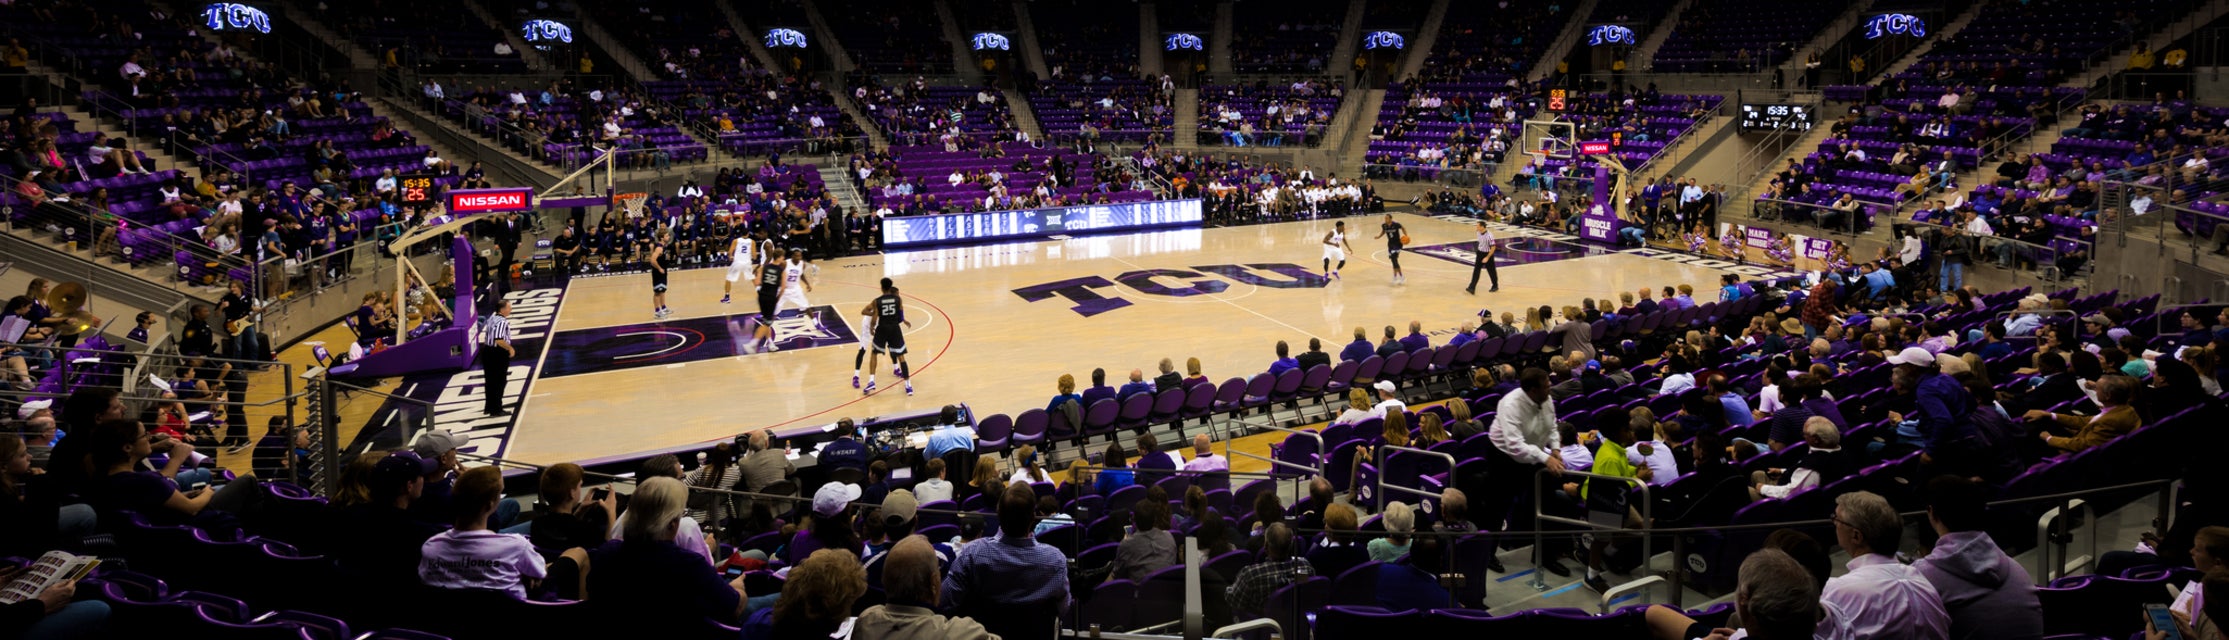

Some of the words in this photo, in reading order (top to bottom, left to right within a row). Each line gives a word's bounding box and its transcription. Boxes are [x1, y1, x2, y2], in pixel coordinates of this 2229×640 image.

[201, 3, 271, 34] TCU
[522, 19, 573, 43] TCU
[1864, 13, 1926, 38] TCU
[764, 28, 807, 48] TCU
[1364, 31, 1405, 50] TCU
[1587, 24, 1635, 46] TCU
[971, 32, 1010, 51] TCU
[1165, 33, 1203, 51] TCU
[1551, 97, 1564, 110] 25
[1767, 106, 1789, 116] 15:35
[1584, 144, 1608, 152] NISSAN
[403, 178, 431, 188] 15:35
[407, 189, 426, 201] 25
[459, 195, 521, 207] NISSAN
[1065, 219, 1088, 230] TCU
[1585, 217, 1612, 231] MUSCLE
[1590, 227, 1606, 239] MILK
[1748, 228, 1768, 239] MAKE
[741, 245, 748, 254] 2
[1812, 239, 1828, 251] GET
[1010, 263, 1332, 317] TCU
[882, 304, 896, 316] 25
[1616, 485, 1627, 506] 3
[1690, 557, 1704, 569] TCU
